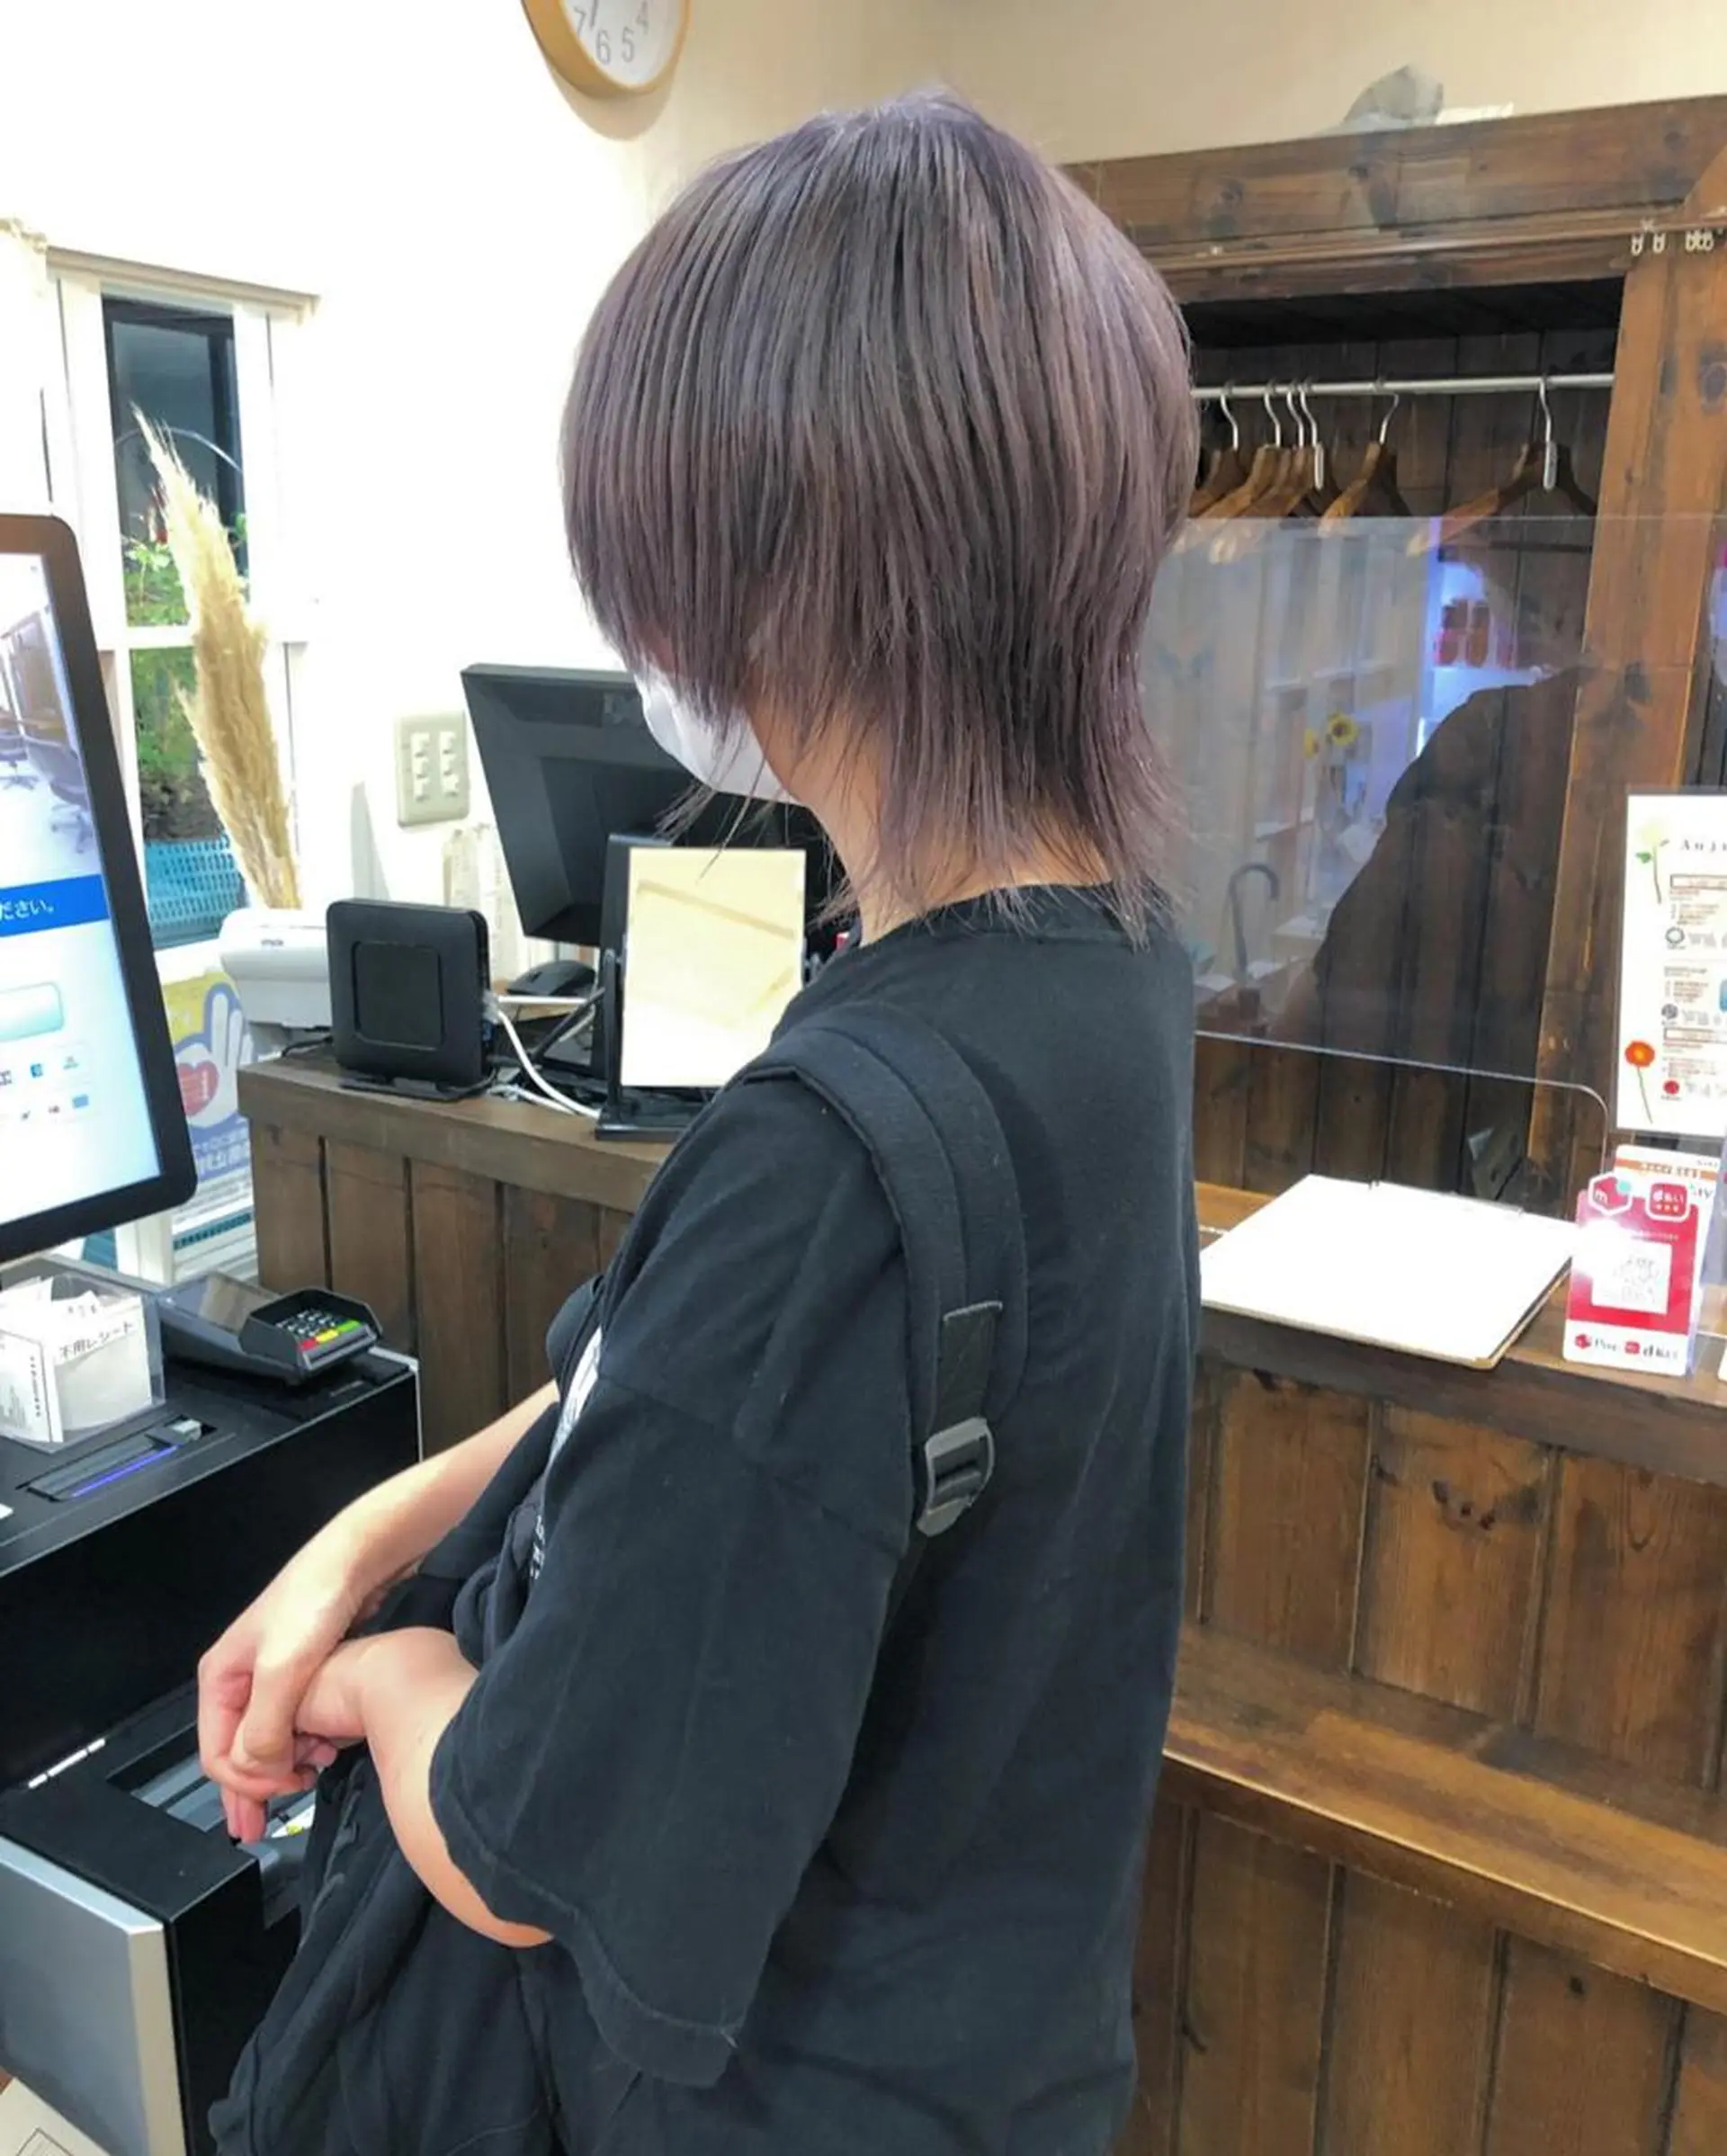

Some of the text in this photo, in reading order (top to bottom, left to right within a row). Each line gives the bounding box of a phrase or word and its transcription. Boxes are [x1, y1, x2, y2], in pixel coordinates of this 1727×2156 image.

[573, 5, 586, 37] 7
[595, 28, 612, 66] 6
[622, 26, 635, 63] 5
